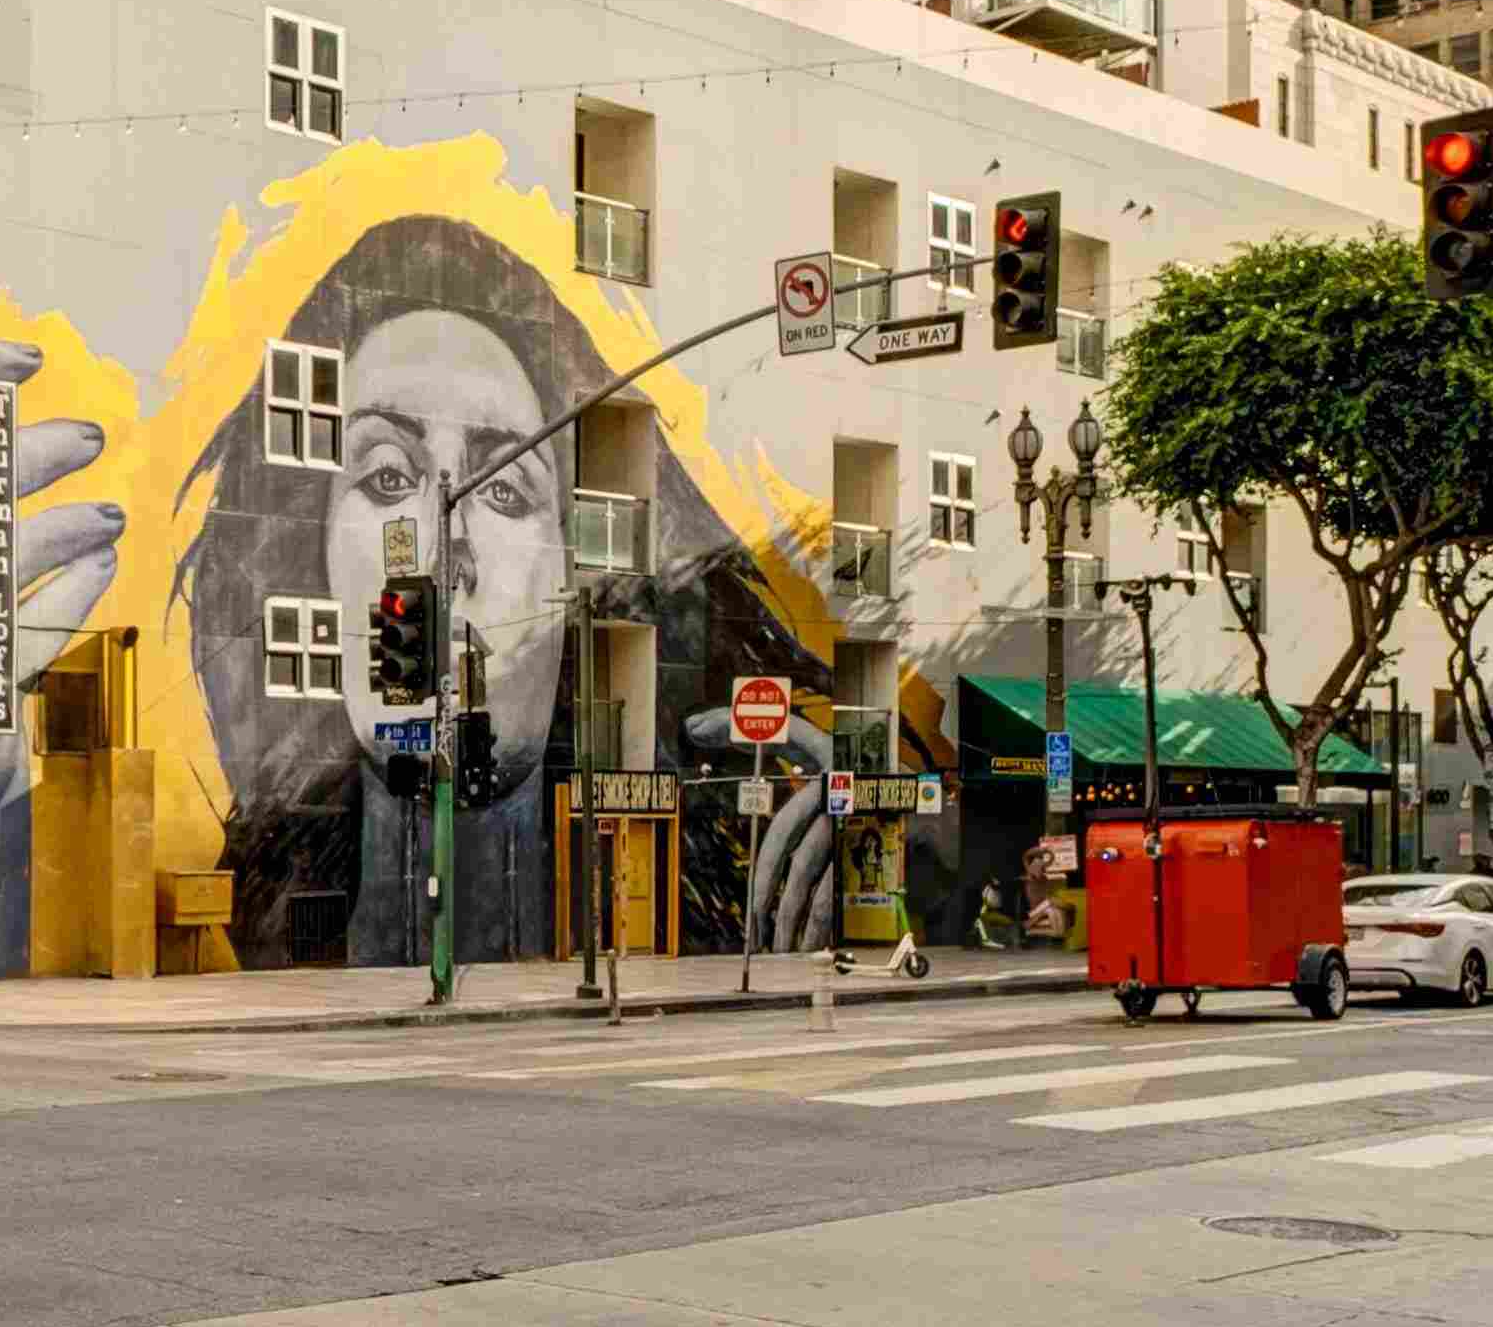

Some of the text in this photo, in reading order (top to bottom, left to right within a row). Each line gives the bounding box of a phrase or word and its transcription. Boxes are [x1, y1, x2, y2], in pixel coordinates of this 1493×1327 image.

[785, 324, 828, 343] ON RED
[878, 327, 951, 350] ONE WAY
[741, 690, 780, 702] DO NOT
[743, 719, 776, 730] ENTER
[830, 774, 852, 791] ATM
